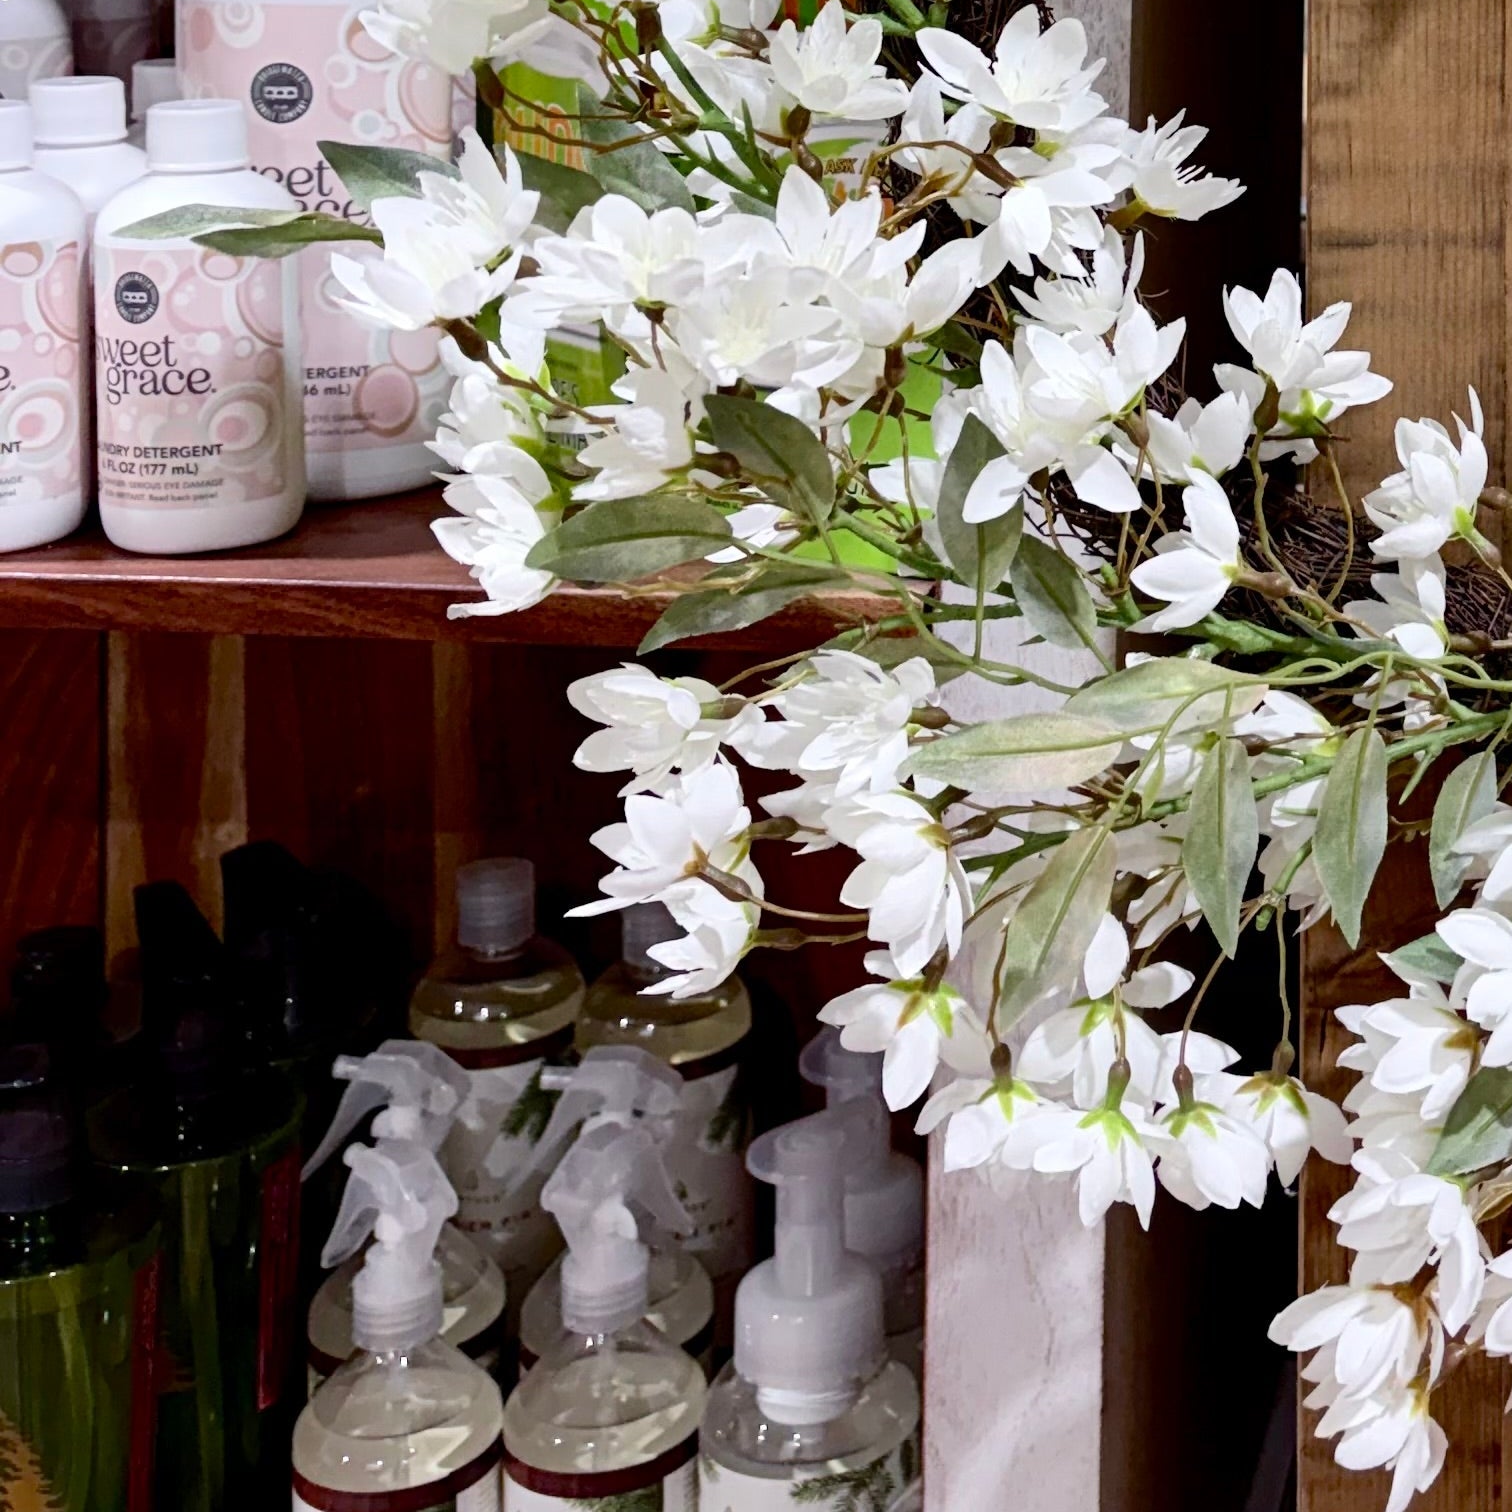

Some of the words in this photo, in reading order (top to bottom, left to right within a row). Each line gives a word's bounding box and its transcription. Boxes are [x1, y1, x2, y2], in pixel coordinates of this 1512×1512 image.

[305, 365, 369, 380] ERGENT
[133, 444, 224, 459] DETERGENT
[119, 461, 136, 474] OZ
[139, 463, 167, 476] (177
[171, 462, 199, 475] mL)
